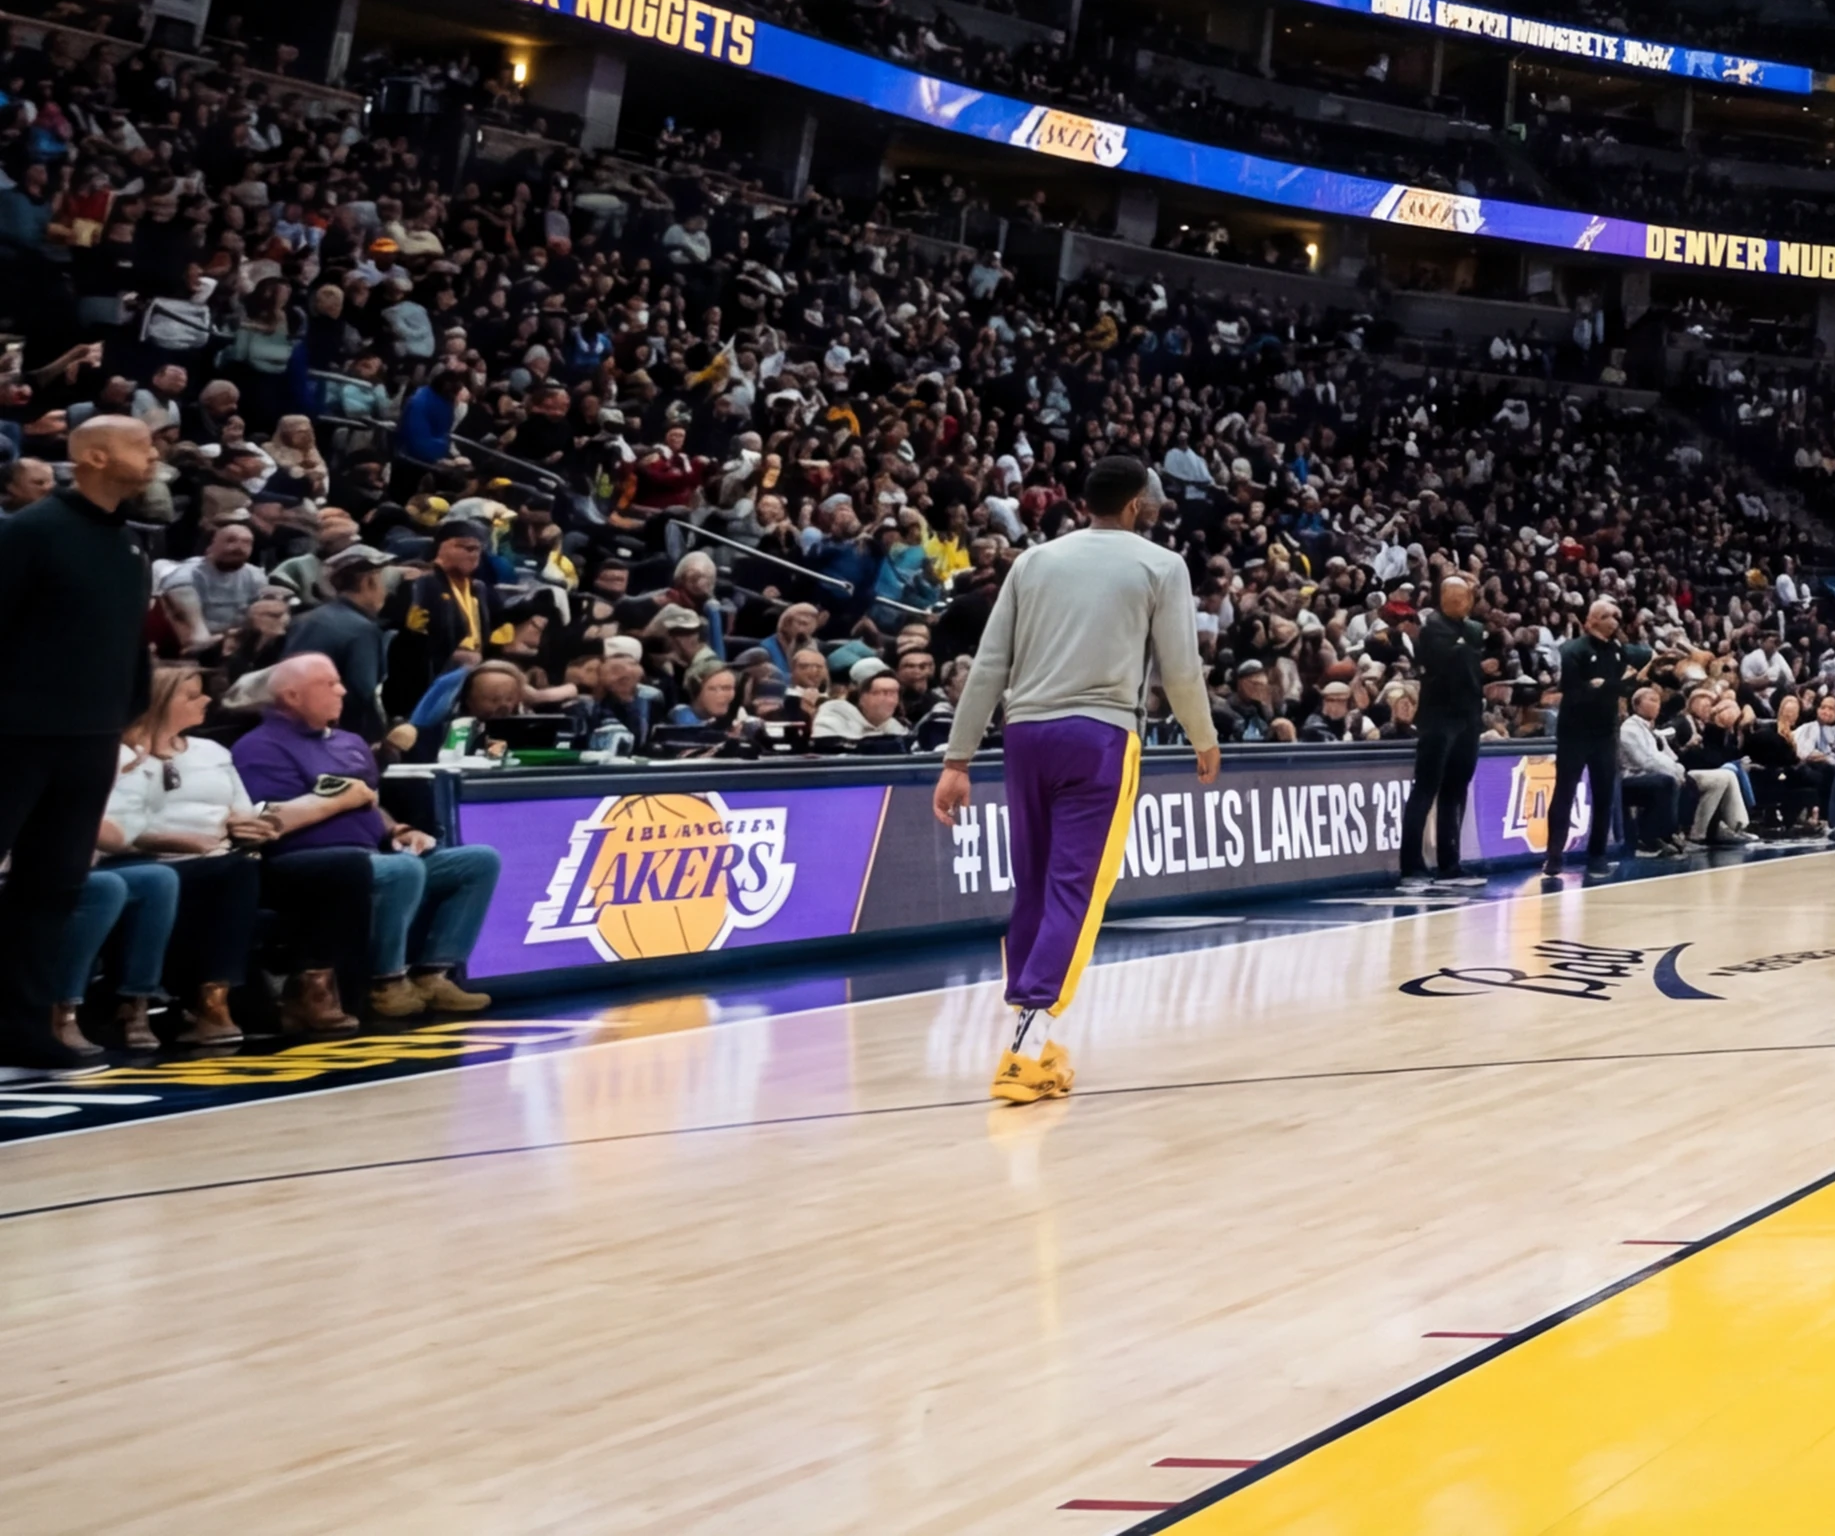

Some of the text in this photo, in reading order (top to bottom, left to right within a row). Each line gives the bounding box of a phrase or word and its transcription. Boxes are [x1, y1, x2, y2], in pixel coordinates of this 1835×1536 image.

[1645, 224, 1768, 272] DENVER
[1249, 782, 1369, 864] LAKERS
[541, 826, 776, 930] LAKERS
